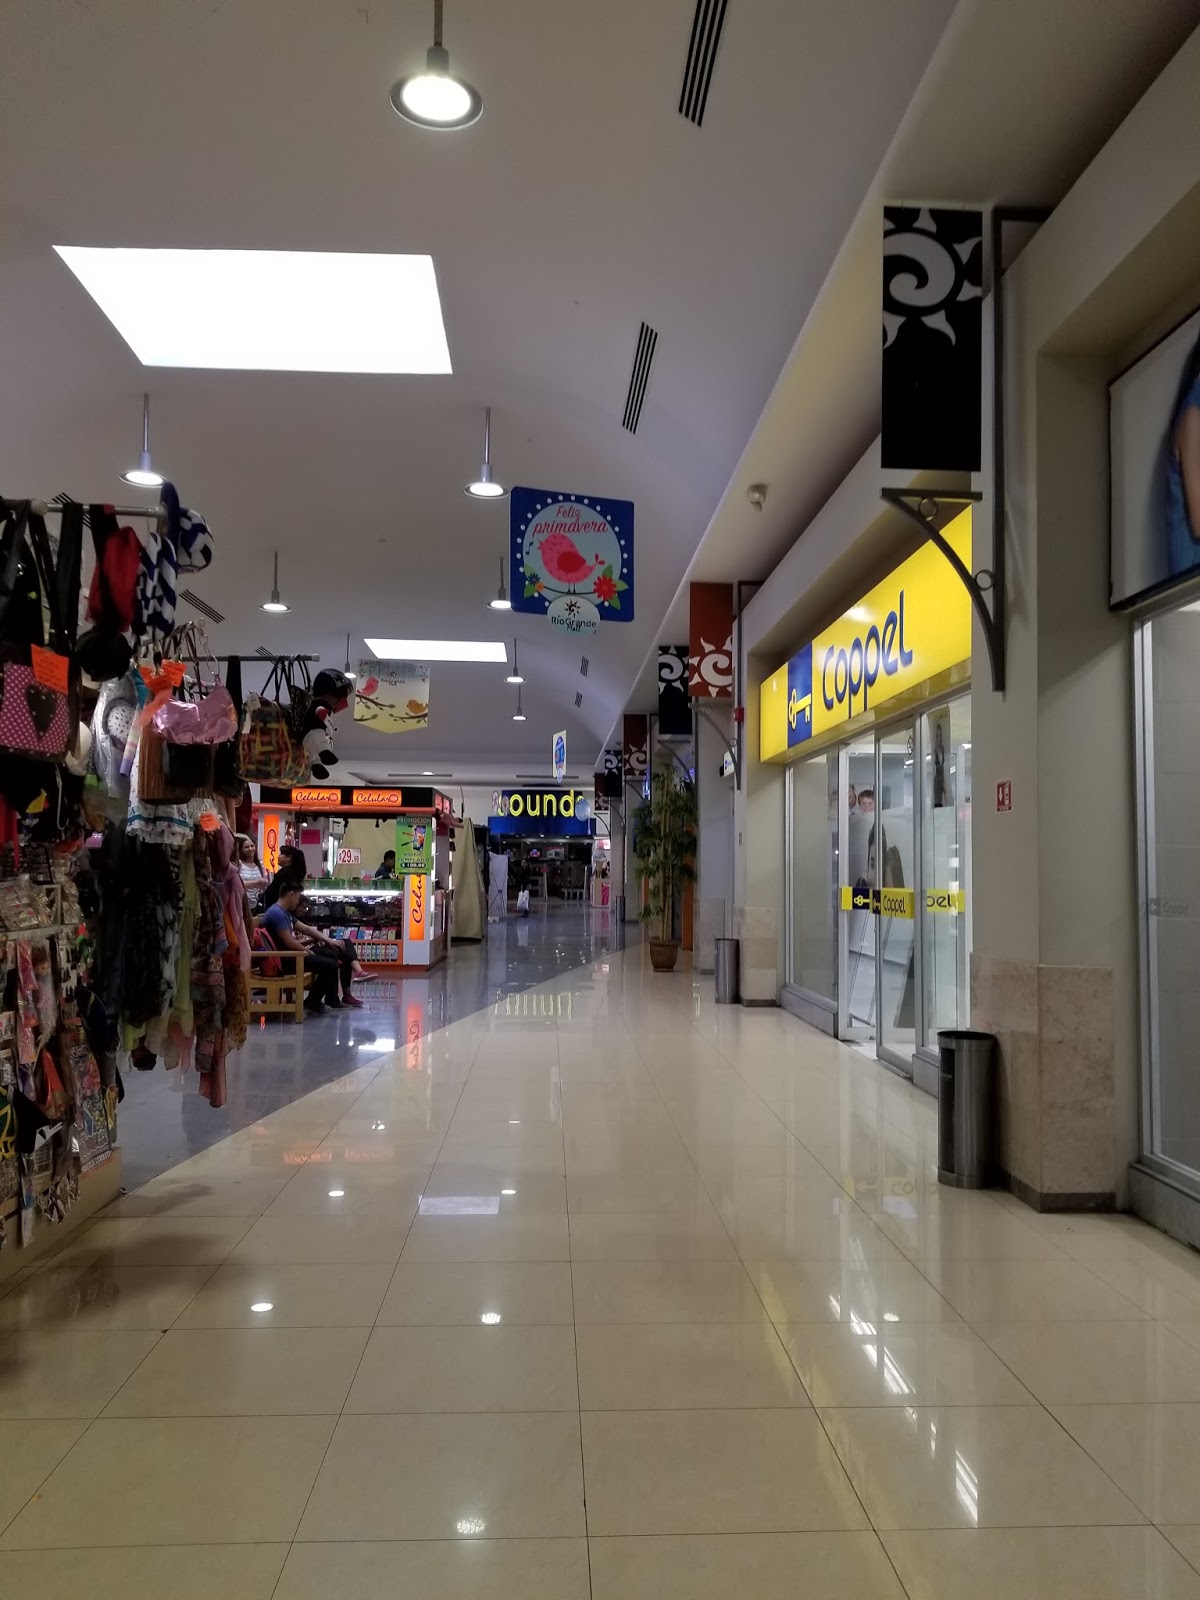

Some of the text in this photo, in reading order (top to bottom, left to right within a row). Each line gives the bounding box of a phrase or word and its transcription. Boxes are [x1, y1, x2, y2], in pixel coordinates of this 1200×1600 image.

[556, 505, 582, 523] Feliz
[532, 520, 609, 538] primavera
[822, 589, 913, 719] Coppel
[497, 788, 584, 817] ound
[412, 875, 422, 924] Celu
[883, 895, 906, 917] Coppel
